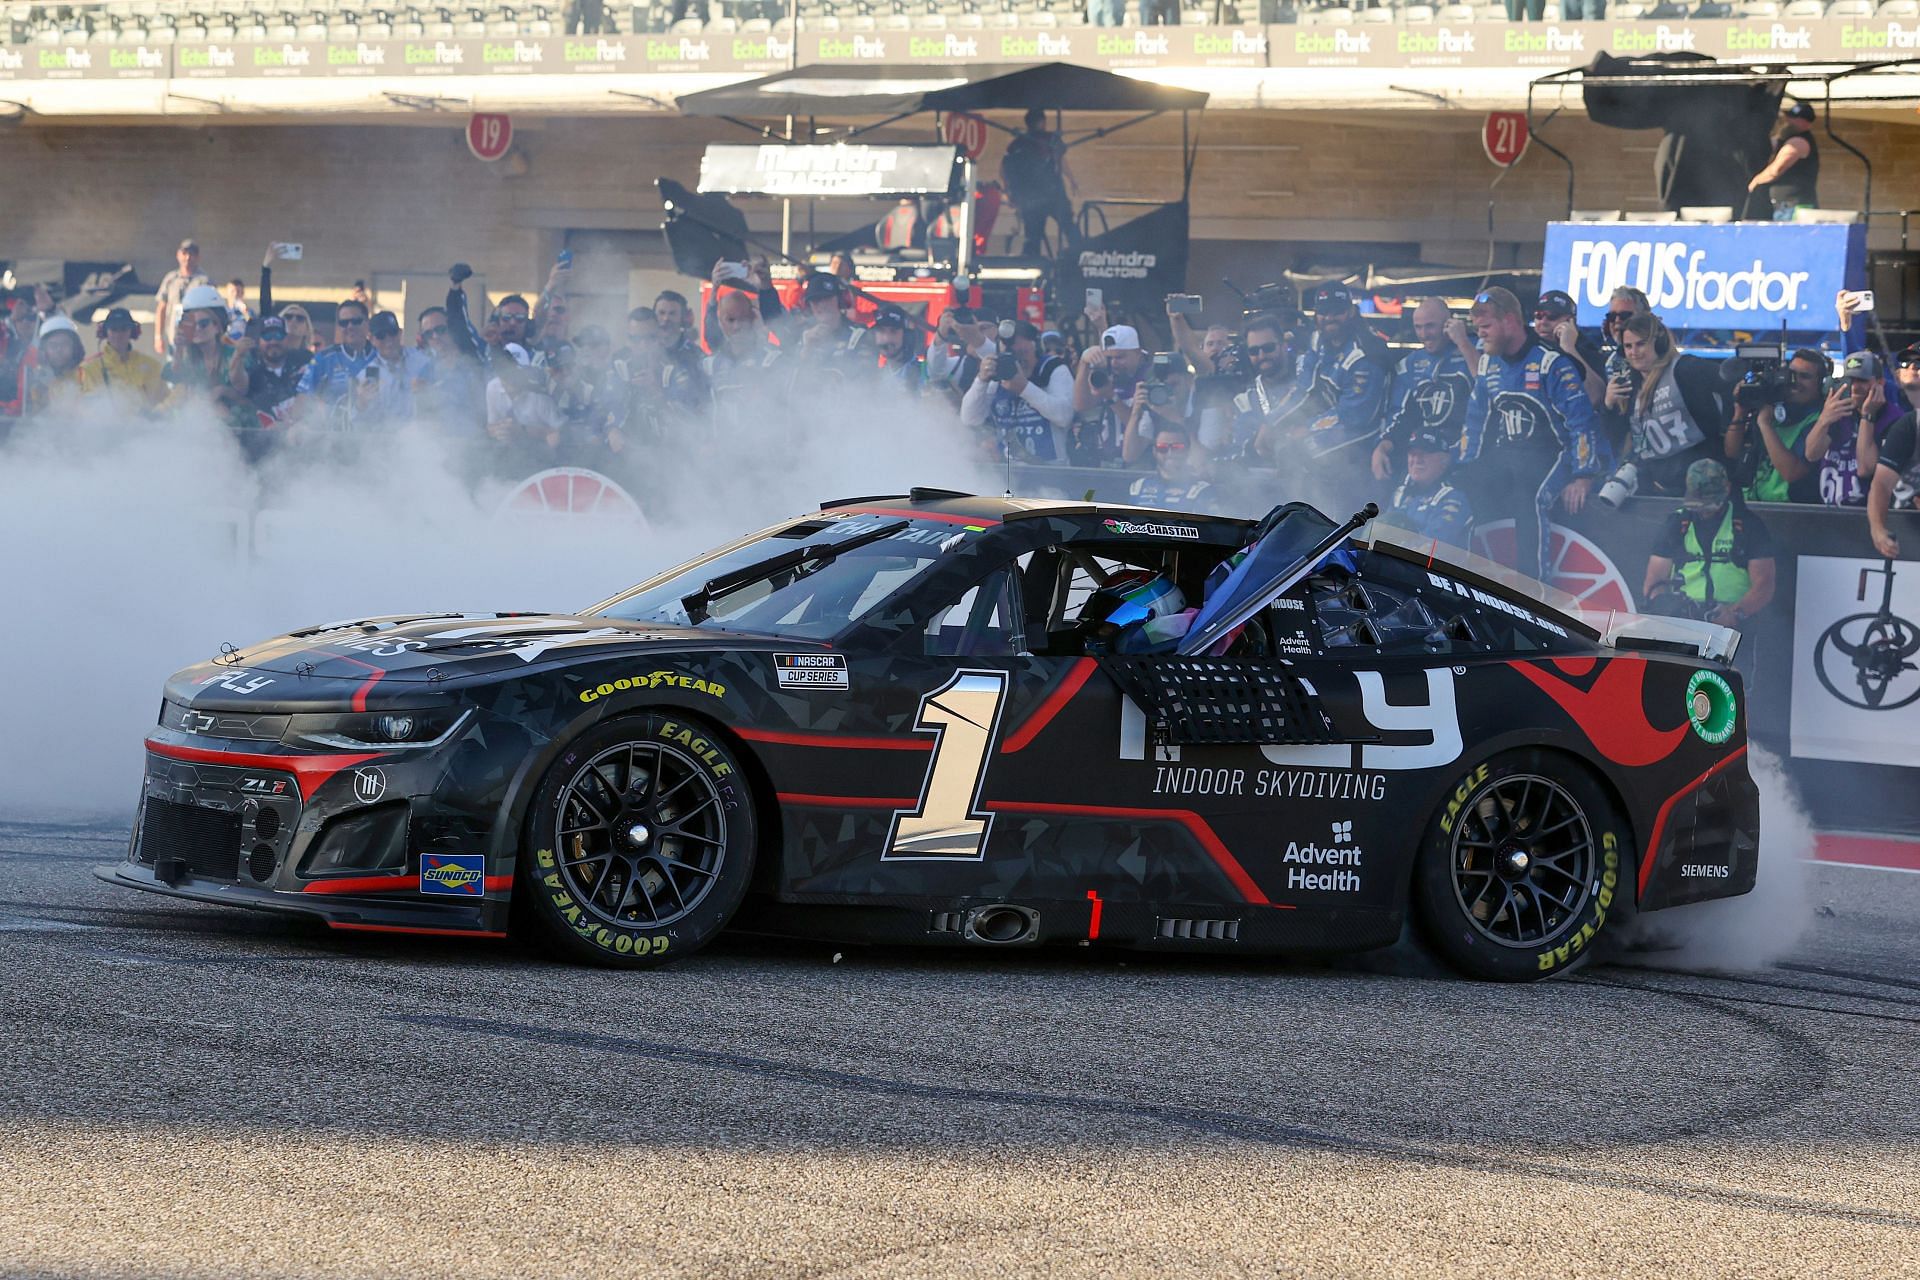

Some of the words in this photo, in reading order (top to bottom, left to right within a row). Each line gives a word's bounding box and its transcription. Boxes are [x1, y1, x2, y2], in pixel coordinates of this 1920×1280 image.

[732, 36, 790, 59] EchoPar
[819, 35, 884, 58] EchoPark
[909, 34, 978, 57] EchoPark
[1001, 32, 1071, 55] EchoPark
[1097, 31, 1168, 55] EchoPark
[1194, 30, 1266, 54] EchoPark
[1295, 28, 1371, 52] EchoPark
[1398, 27, 1475, 52] EchoPark
[1504, 26, 1584, 51] EchoPark
[1613, 25, 1695, 50] EchoPark
[1726, 23, 1811, 49] EchoPark
[39, 47, 91, 68] EchoPark
[110, 46, 162, 67] EchoPark
[180, 45, 234, 66] EchoPark
[254, 44, 309, 65] EchoPark
[328, 44, 385, 64] EchoPark
[405, 42, 463, 63] EchoPark
[483, 40, 542, 62] EchoPark
[564, 40, 625, 61] EchoPark
[646, 38, 709, 60] EchoPark
[482, 118, 501, 150] 19
[1495, 118, 1517, 154] 21
[1082, 267, 1148, 279] TRACTORS
[1120, 522, 1148, 534] Ross
[1147, 524, 1199, 538] CHASTAIN
[1271, 599, 1305, 611] MOOSE
[1426, 572, 1453, 593] BE
[1454, 582, 1471, 599] A
[1470, 588, 1569, 639] MOOSE.ORG
[1280, 637, 1310, 647] Advent
[1283, 646, 1312, 655] Health
[797, 656, 835, 667] NASCAR
[579, 671, 726, 703] GOODYEAR
[787, 670, 807, 682] CUP
[807, 671, 839, 683] SERIES
[658, 721, 732, 778] EAGLE
[880, 667, 1010, 862] 1
[240, 778, 287, 794] ZL1
[1152, 767, 1246, 795] INDOOR
[1255, 770, 1386, 801] SKYDIVING
[1440, 763, 1489, 835] EAGLE
[1282, 841, 1362, 866] Advent
[425, 870, 482, 882] SUNOCO
[1288, 867, 1360, 892] Health
[1680, 864, 1729, 878] SIEMENS
[537, 849, 670, 956] GOODYEAR
[1537, 832, 1619, 972] GOODYEAR
